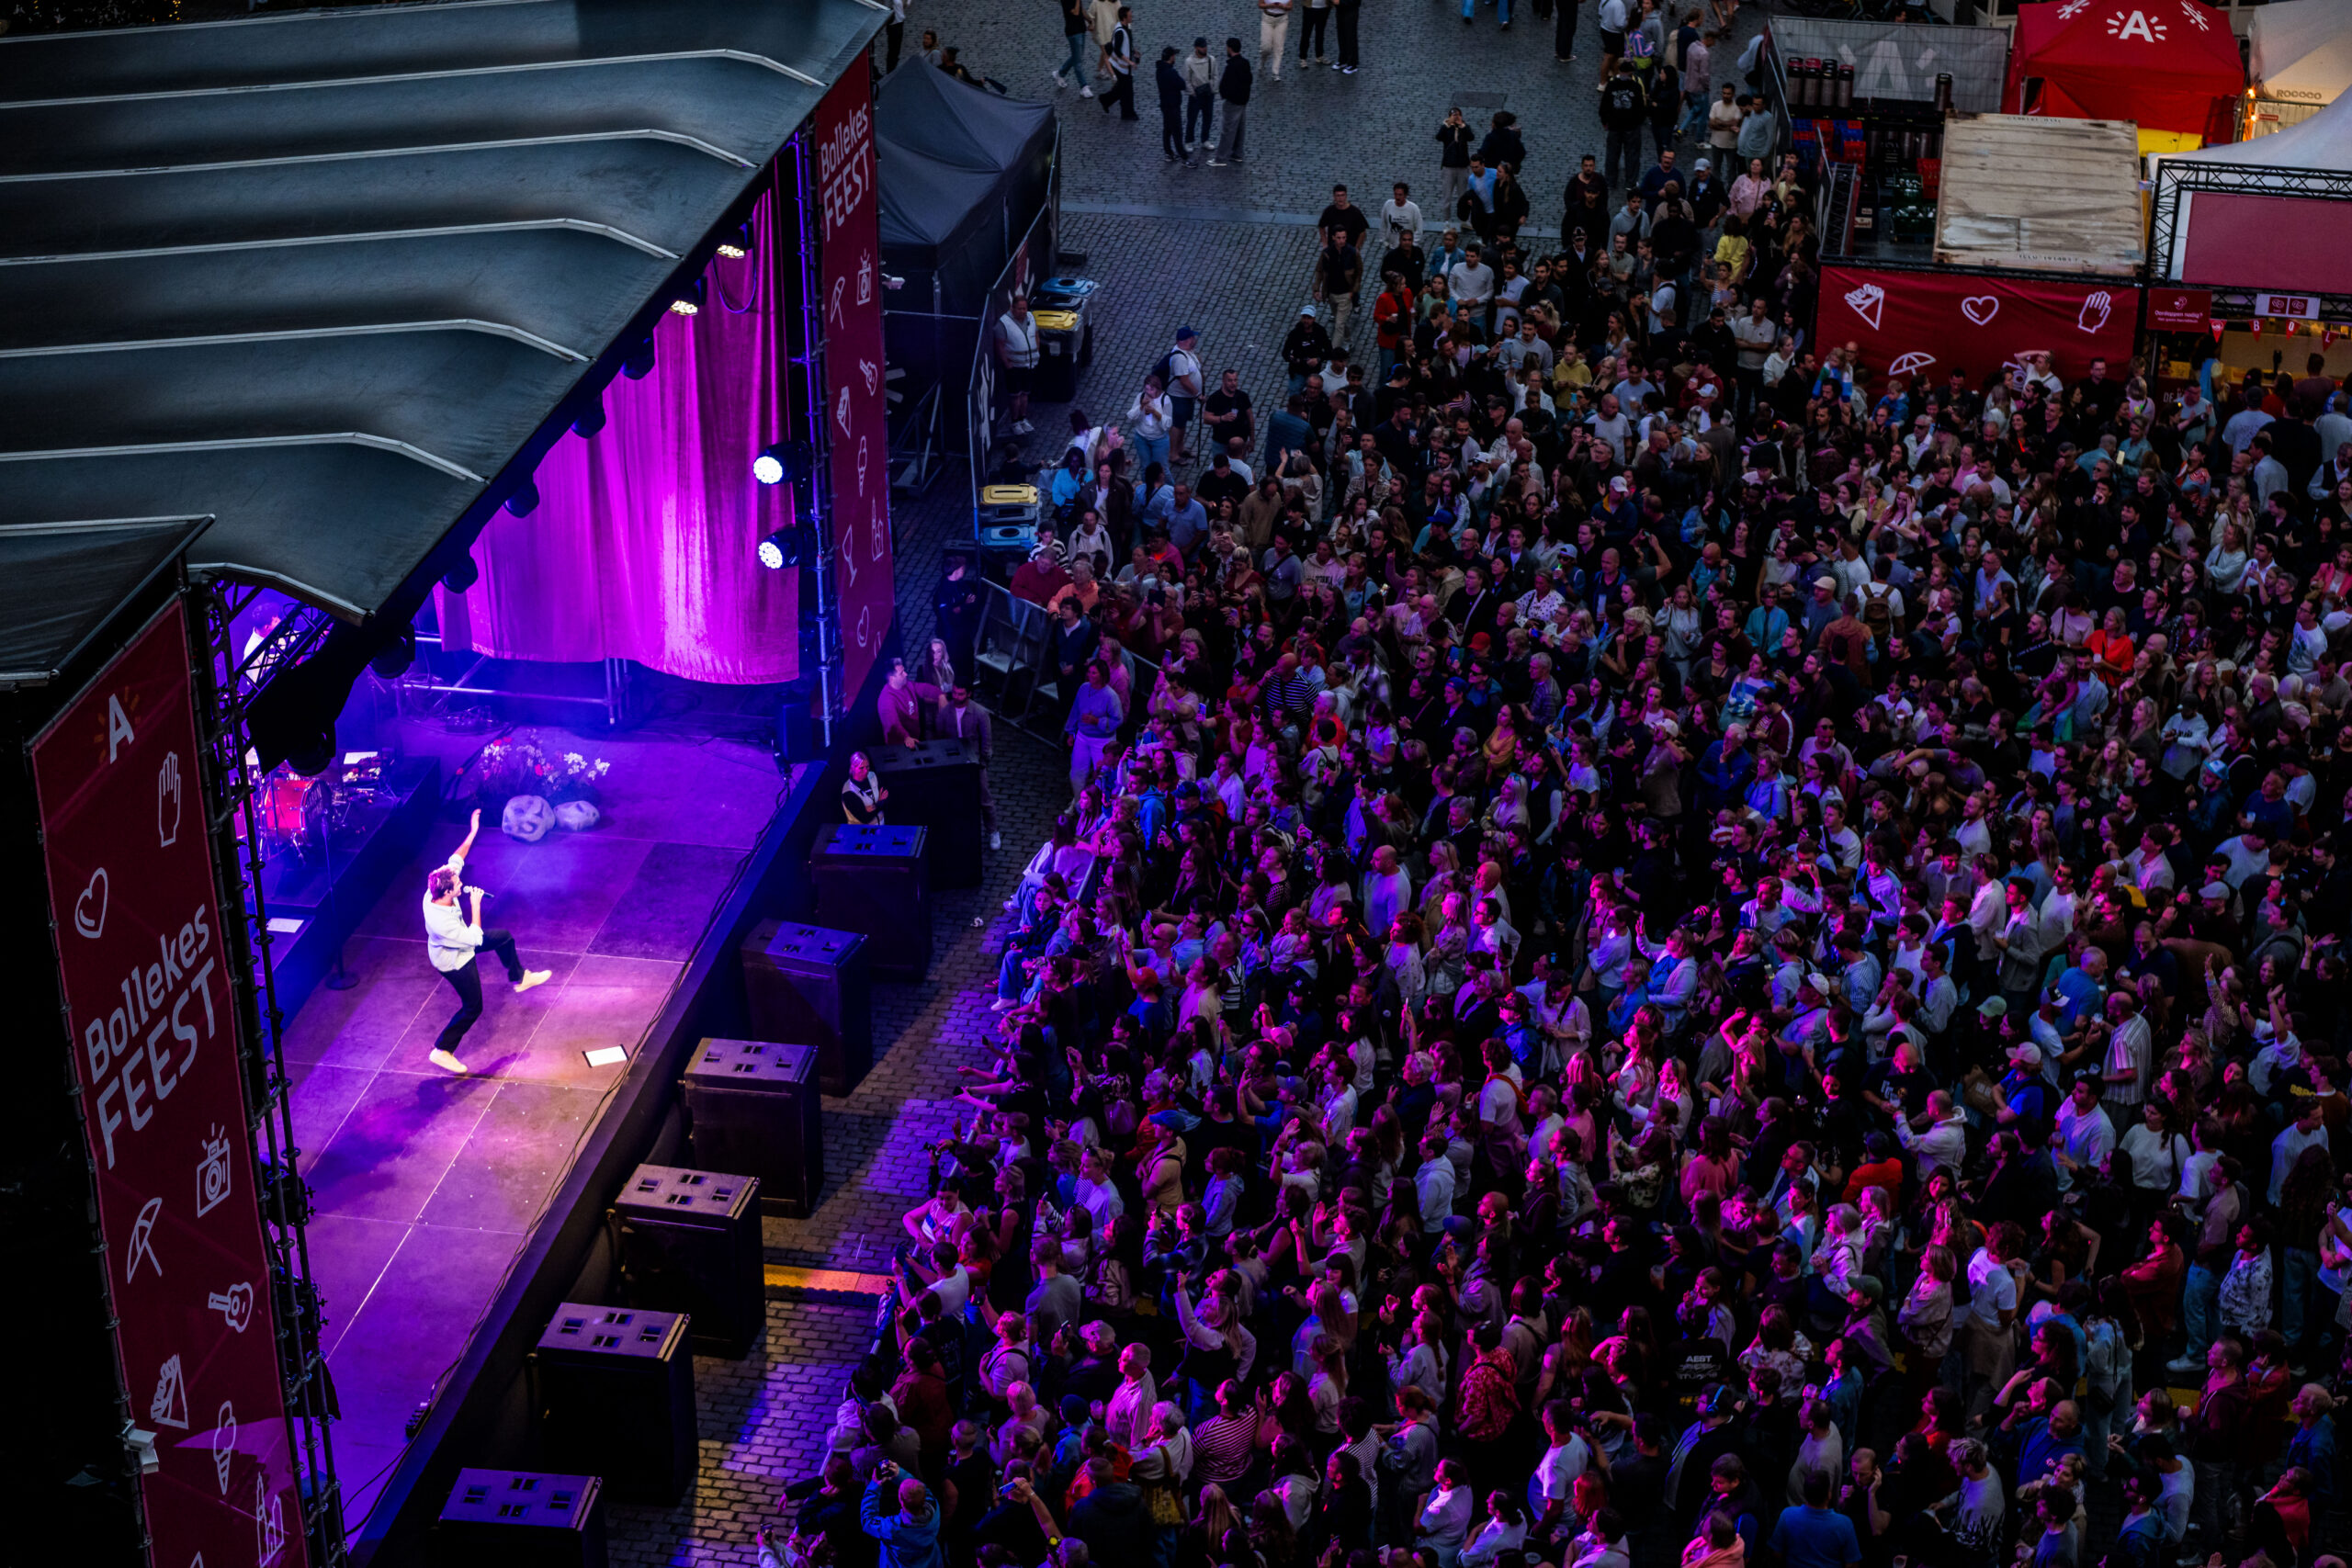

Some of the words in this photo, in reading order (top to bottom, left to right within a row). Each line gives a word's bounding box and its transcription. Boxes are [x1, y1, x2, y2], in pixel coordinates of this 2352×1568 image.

[2119, 10, 2154, 43] A
[2277, 89, 2323, 100] ROCOCO
[820, 103, 869, 184] Bollekes
[824, 141, 869, 242] FEEST
[107, 693, 135, 763] A
[85, 904, 210, 1084] Bollekes
[96, 957, 217, 1170] FEEST
